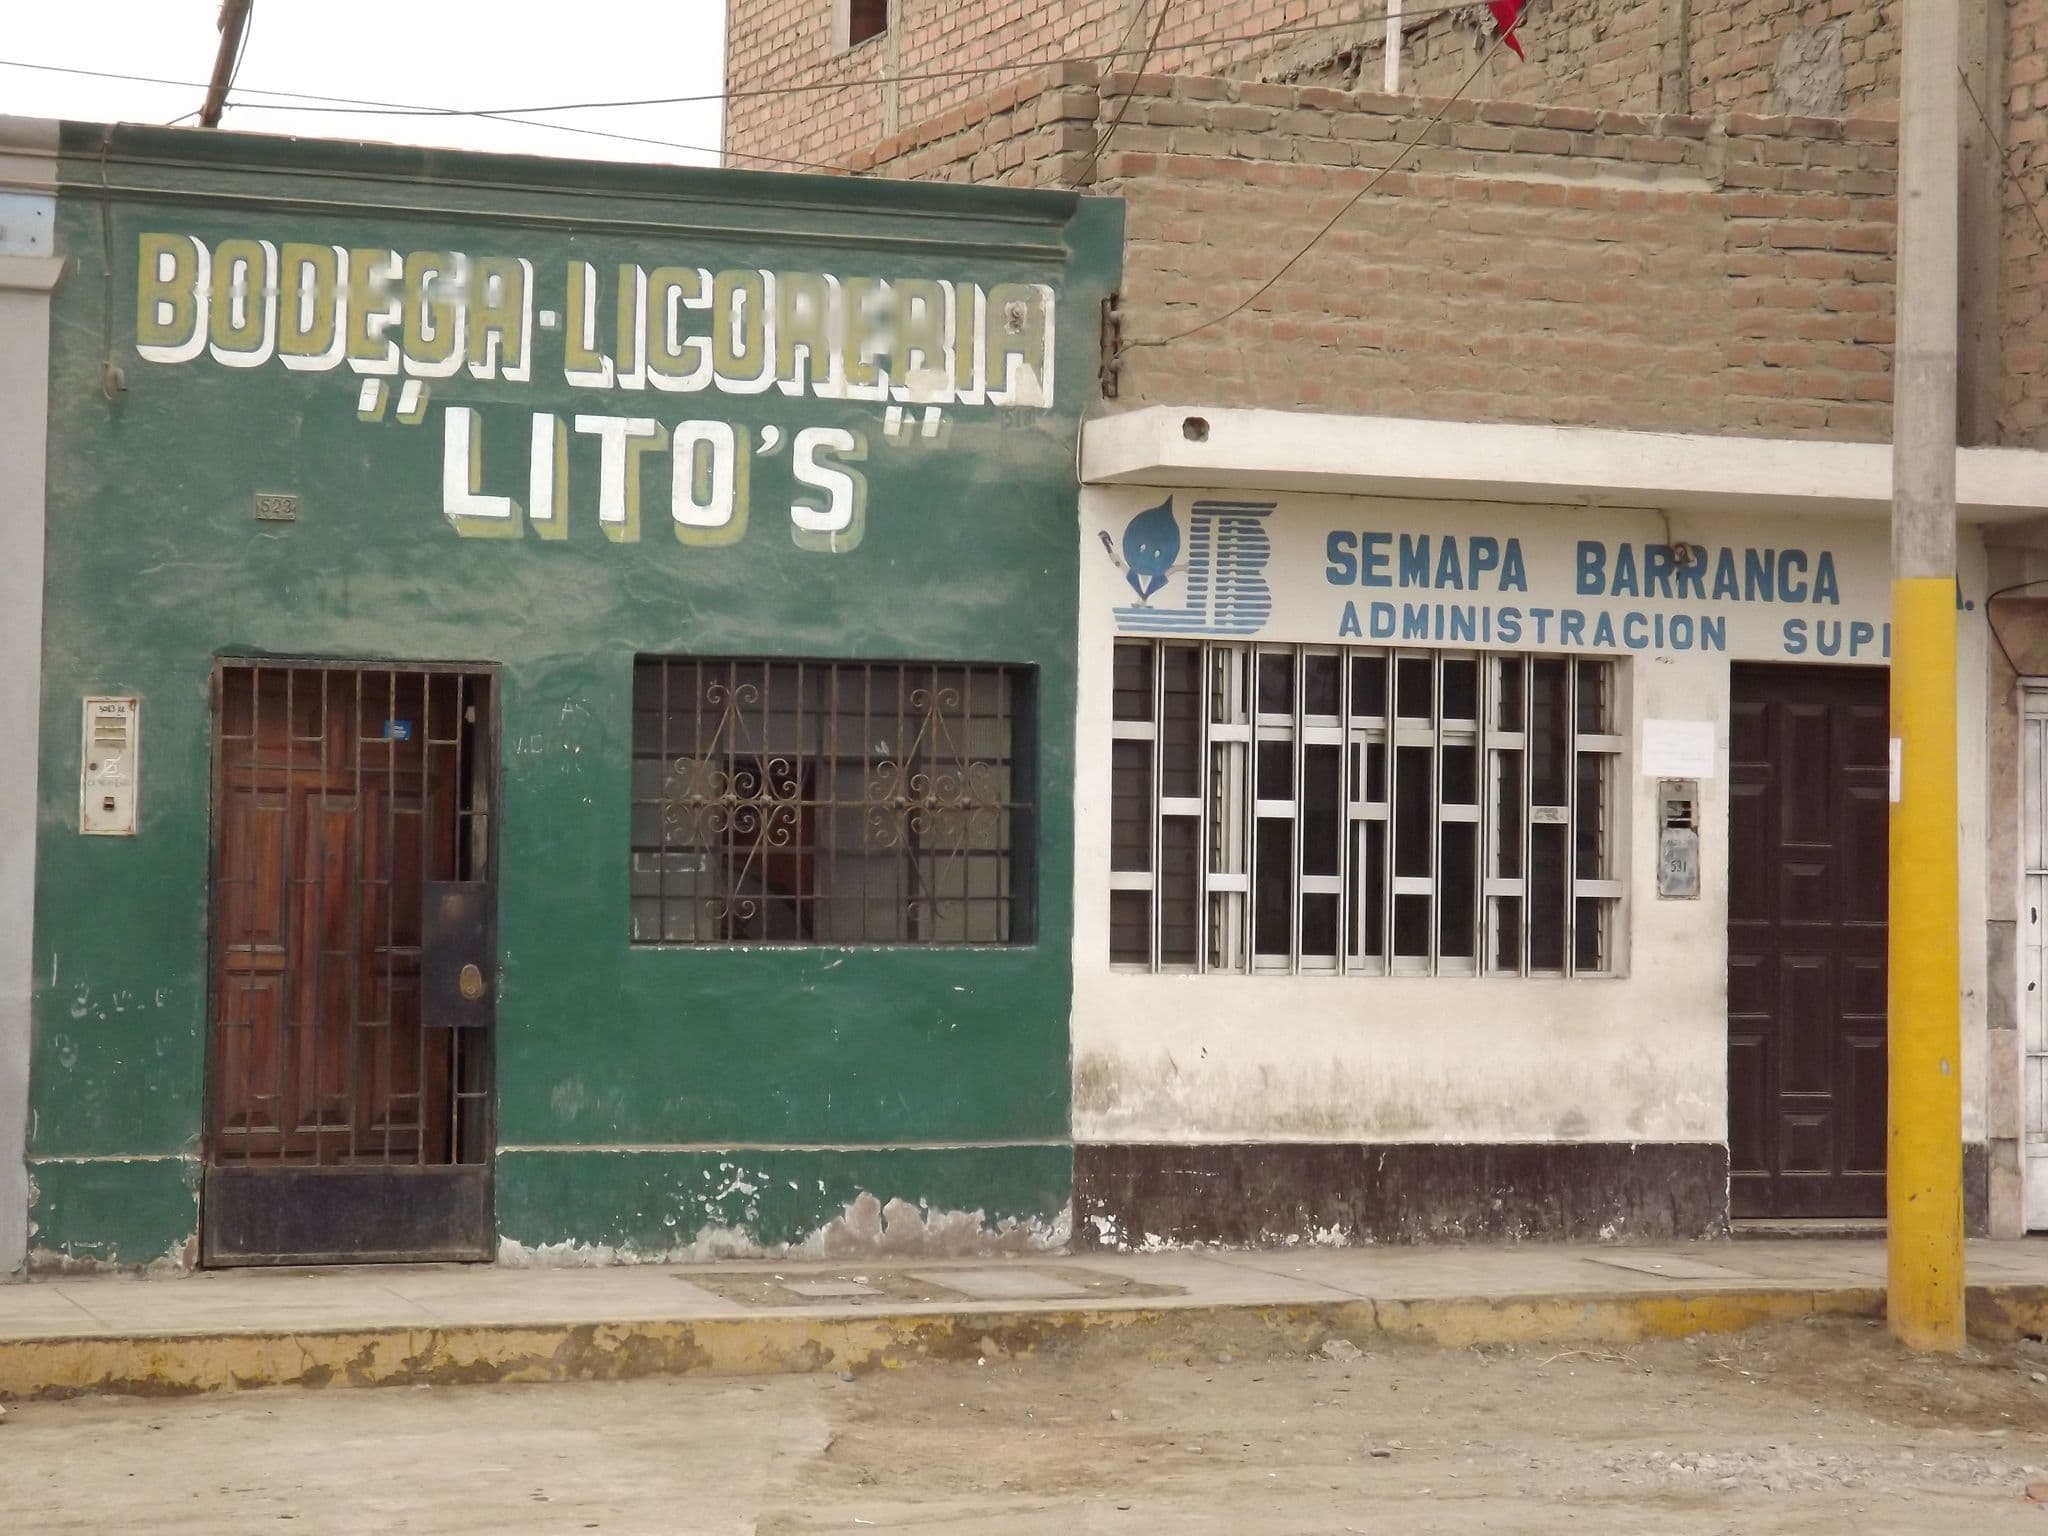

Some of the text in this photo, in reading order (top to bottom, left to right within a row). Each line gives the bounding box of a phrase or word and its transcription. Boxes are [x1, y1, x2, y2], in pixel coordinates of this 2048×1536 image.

[1326, 530, 1528, 592] SEMAPA
[1576, 540, 1840, 605] BARRANCA
[1338, 601, 1726, 651] ADMINISTRACION
